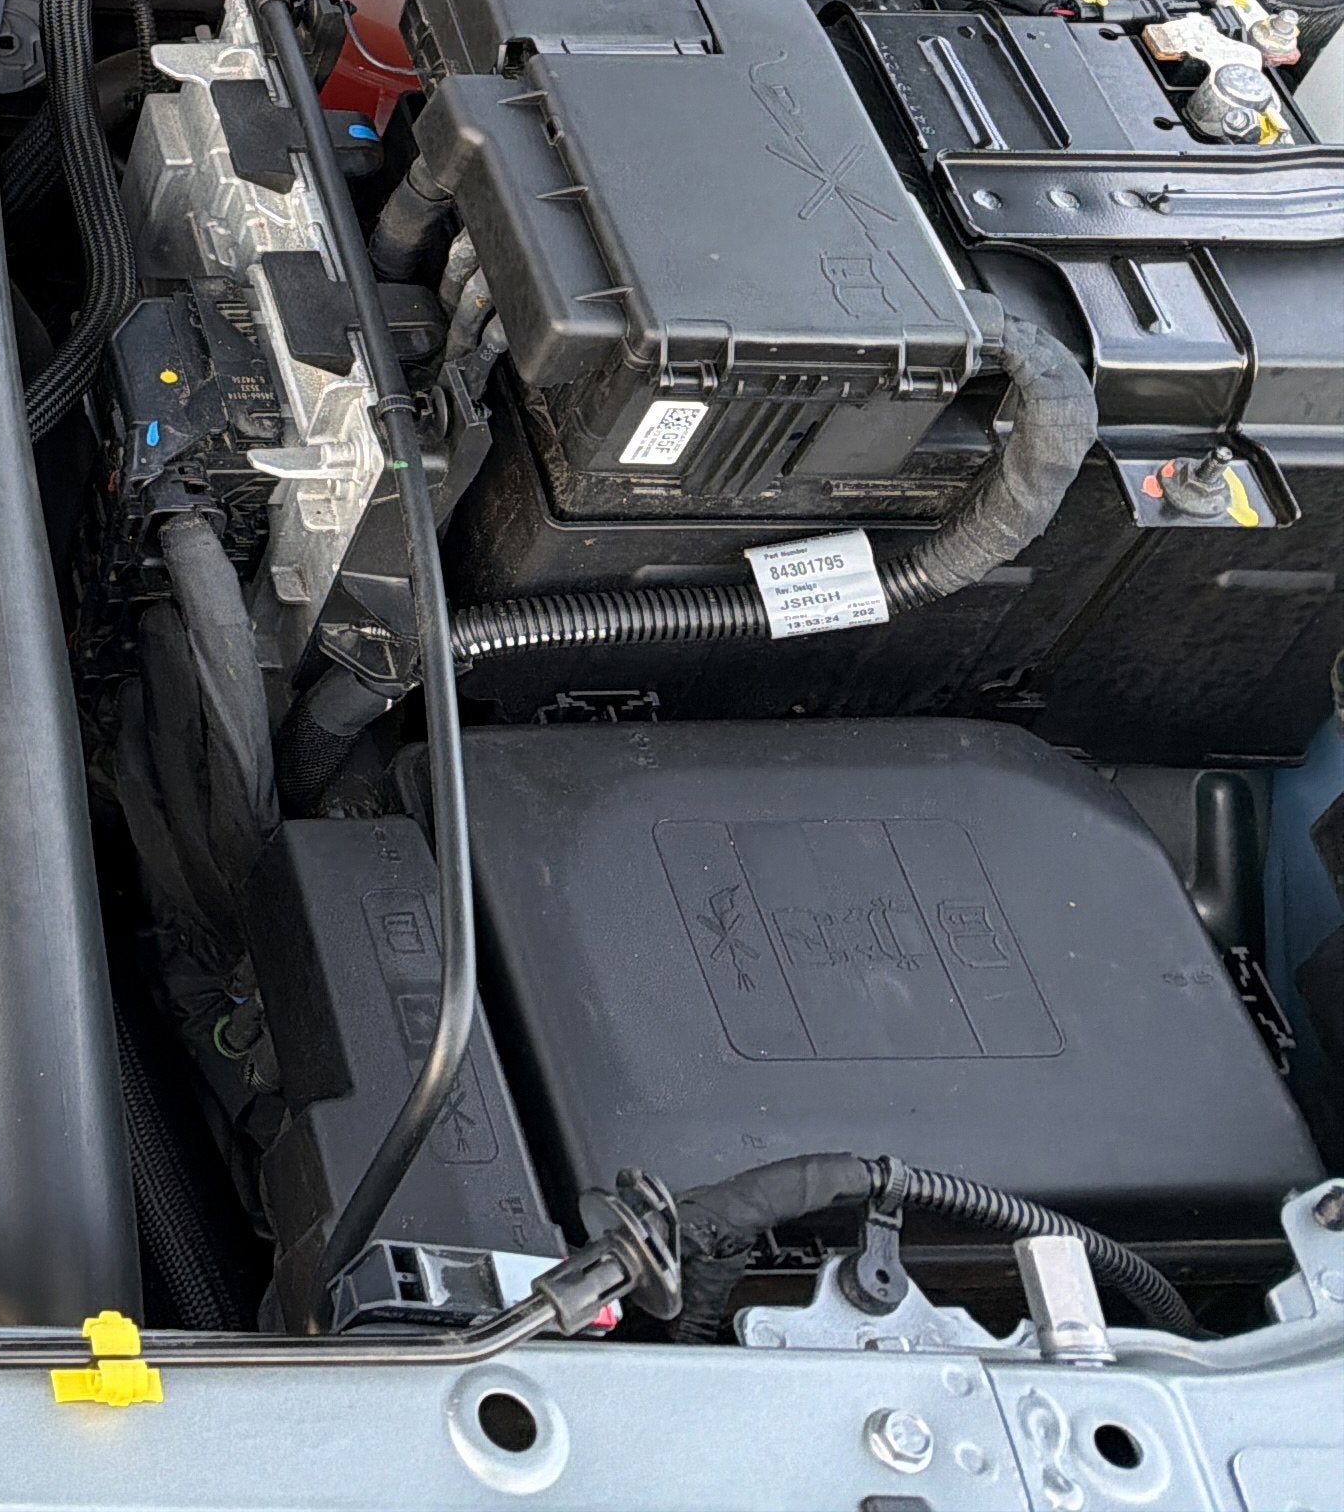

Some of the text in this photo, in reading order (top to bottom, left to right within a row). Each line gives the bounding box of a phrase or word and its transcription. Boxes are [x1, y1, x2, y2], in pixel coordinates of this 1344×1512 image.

[764, 547, 808, 561] Part Number
[769, 554, 845, 581] 84301795
[779, 590, 842, 611] JSRGH
